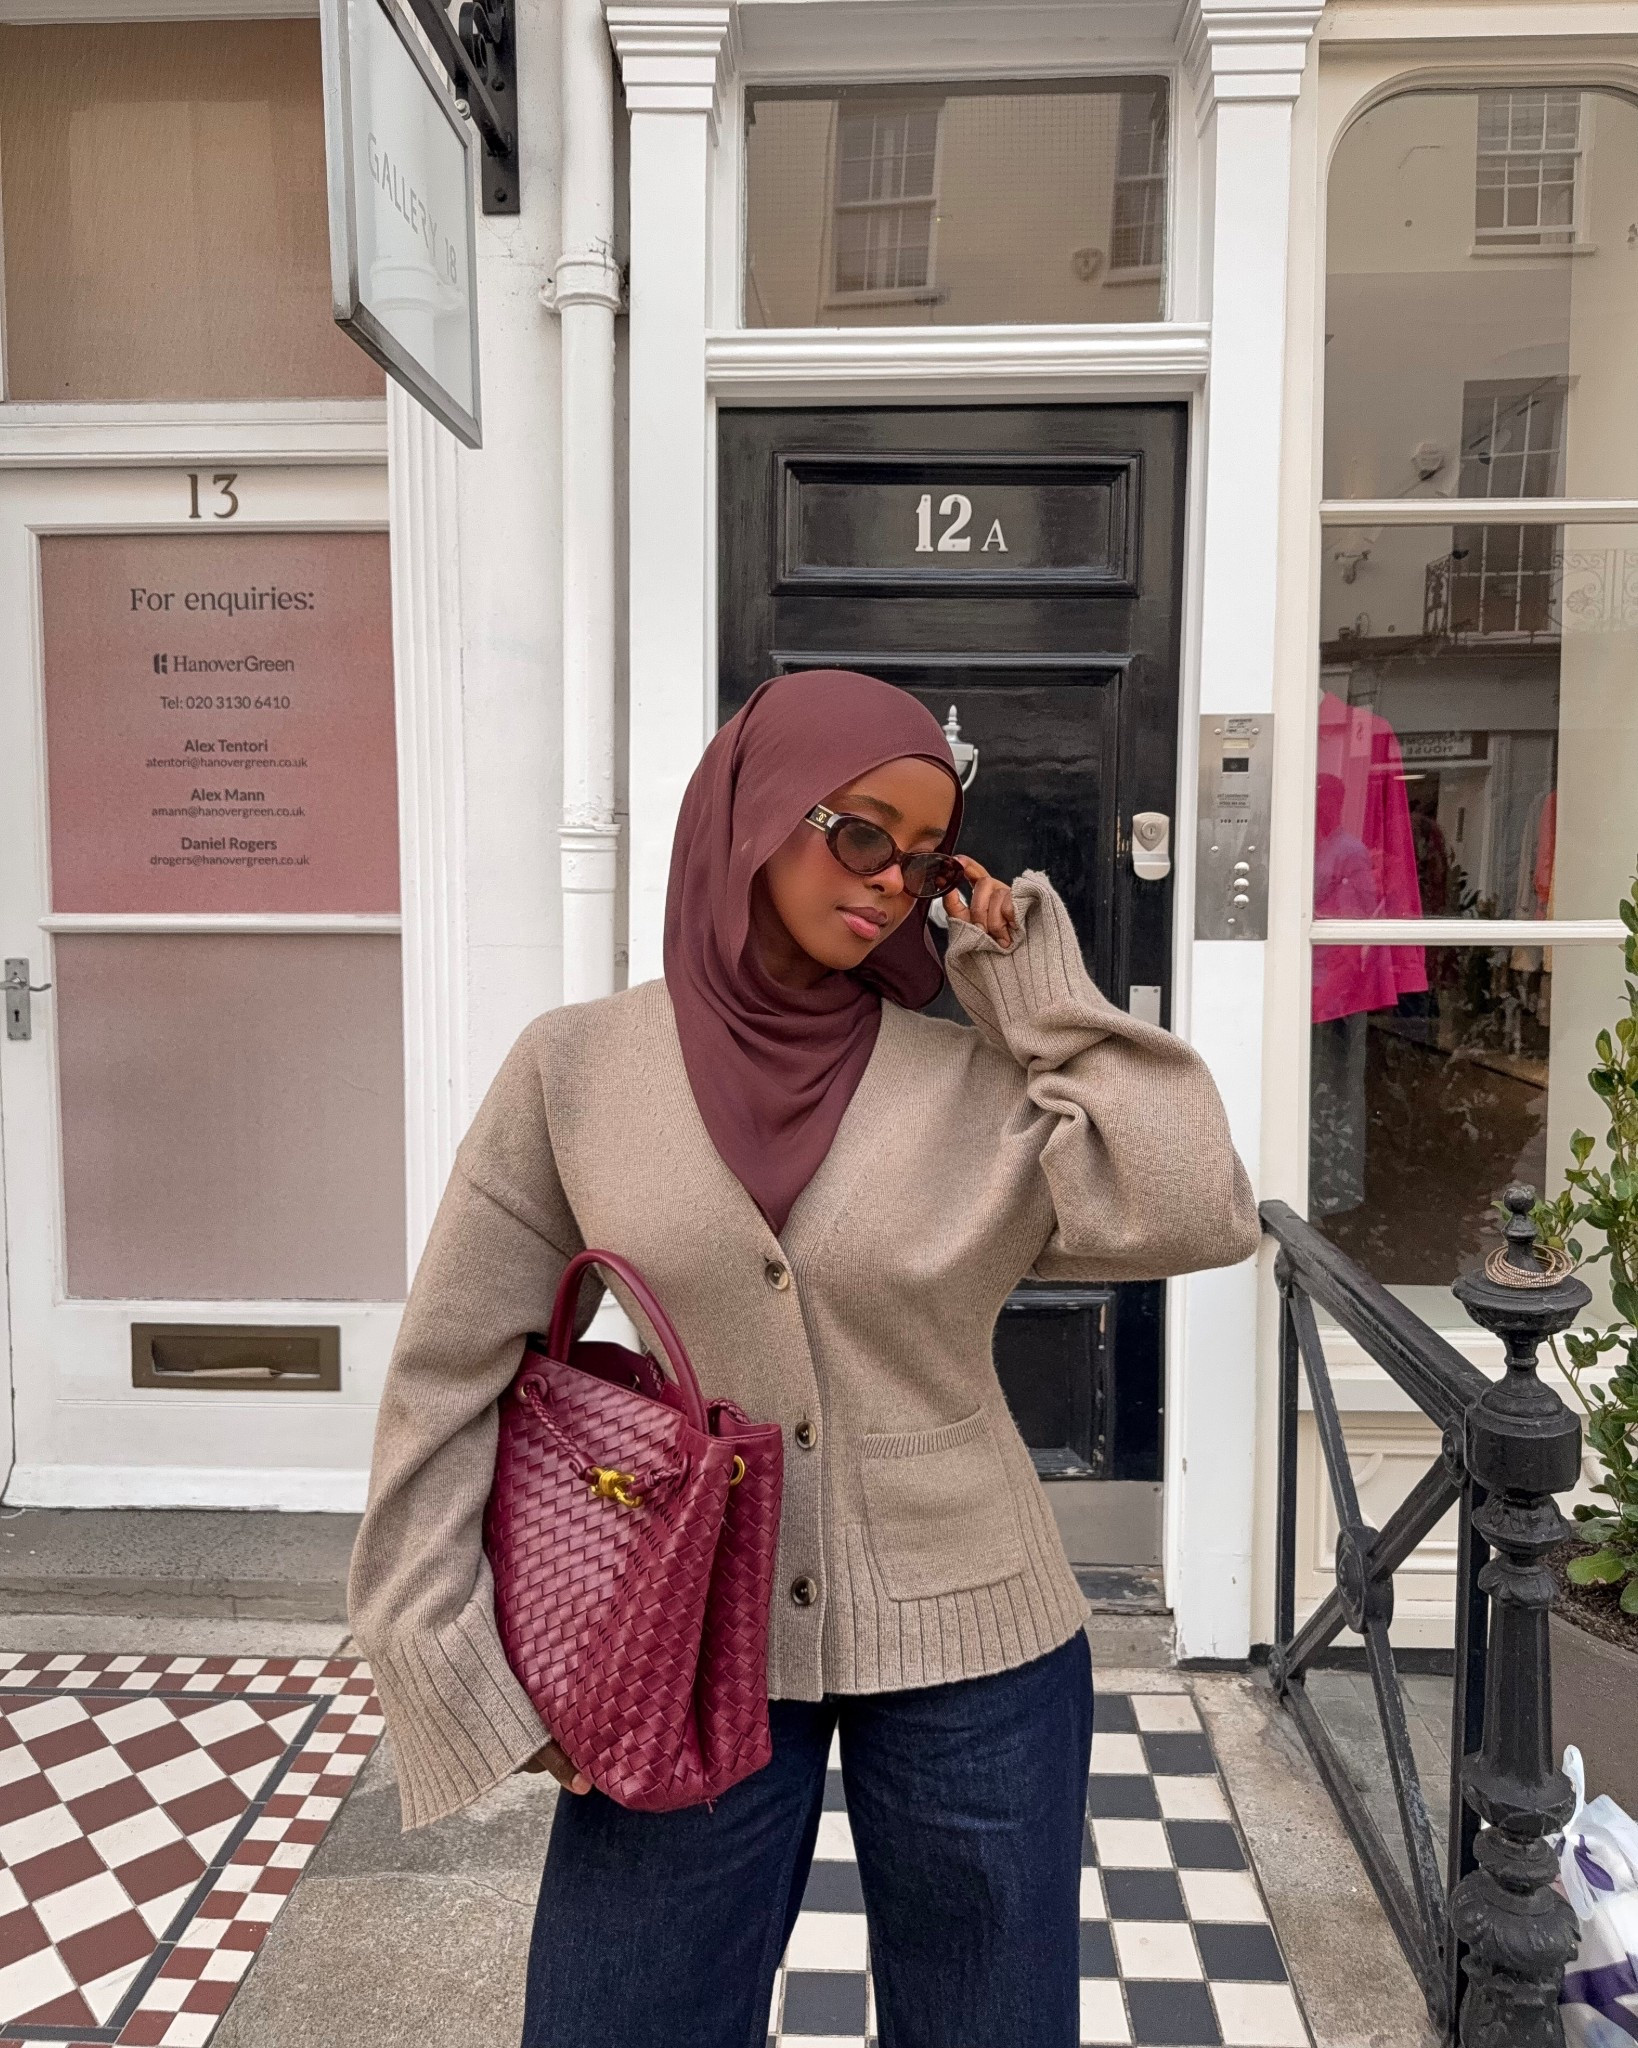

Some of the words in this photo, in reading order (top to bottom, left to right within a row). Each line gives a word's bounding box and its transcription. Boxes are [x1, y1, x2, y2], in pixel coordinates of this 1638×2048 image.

[367, 131, 438, 258] GALLERY
[187, 473, 240, 519] 13
[130, 588, 175, 611] For
[184, 586, 315, 617] enquiries:
[173, 655, 295, 673] HanoverGreen
[160, 695, 183, 709] Tel:
[186, 695, 213, 710] 020
[216, 695, 252, 710] 3130
[255, 695, 291, 710] 6410
[184, 739, 215, 753] Alex
[218, 739, 269, 753] Tentori
[146, 756, 308, 769] atentori@hanovergreen.co.uk
[191, 788, 221, 802] Alex
[224, 789, 265, 802] Mann
[151, 806, 305, 819] amann@hanovergreen.co.uk
[181, 837, 226, 851] Daniel
[229, 837, 278, 853] Rogers
[150, 854, 310, 868] drogers@hanovergreen.co.uk
